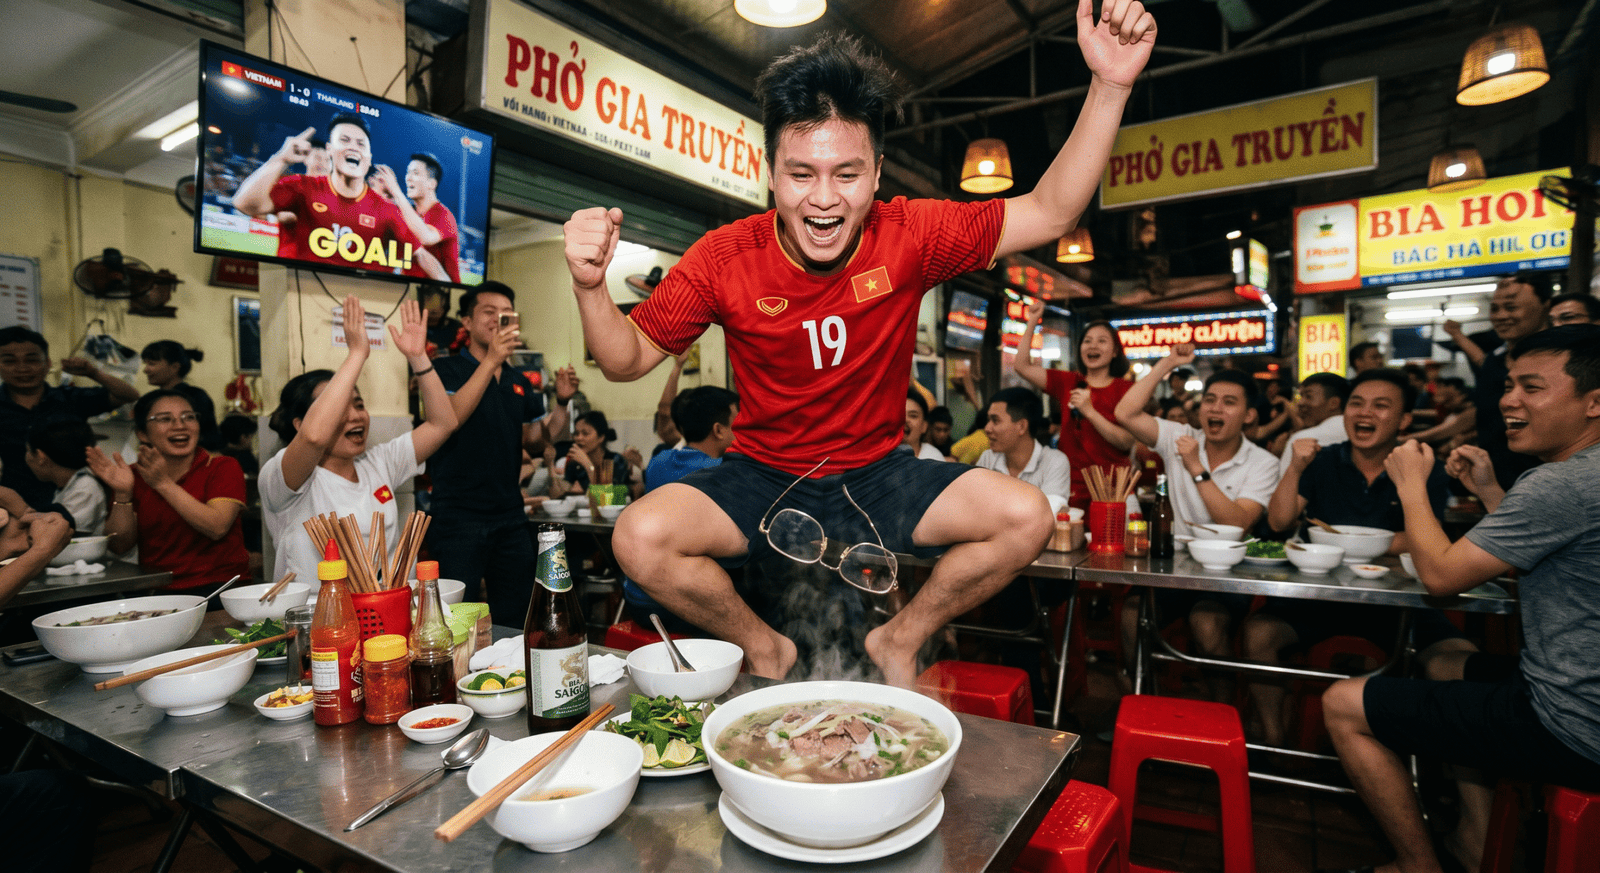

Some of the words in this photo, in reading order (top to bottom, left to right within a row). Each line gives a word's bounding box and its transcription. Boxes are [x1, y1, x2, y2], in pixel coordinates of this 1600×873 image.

[244, 70, 282, 88] VIETNAM
[316, 92, 354, 110] THAILAND
[505, 33, 586, 111] PHỞ
[595, 77, 651, 140] GIA
[661, 105, 763, 182] TRUYỀN
[1109, 135, 1164, 187] PHỞ
[1171, 139, 1224, 177] GIA
[1232, 98, 1366, 168] TRUYỀN
[1369, 204, 1445, 239] BIA
[1460, 188, 1547, 228] HOI
[309, 227, 413, 270] GOAL!
[802, 315, 847, 369] 19
[1306, 323, 1340, 342] BIA
